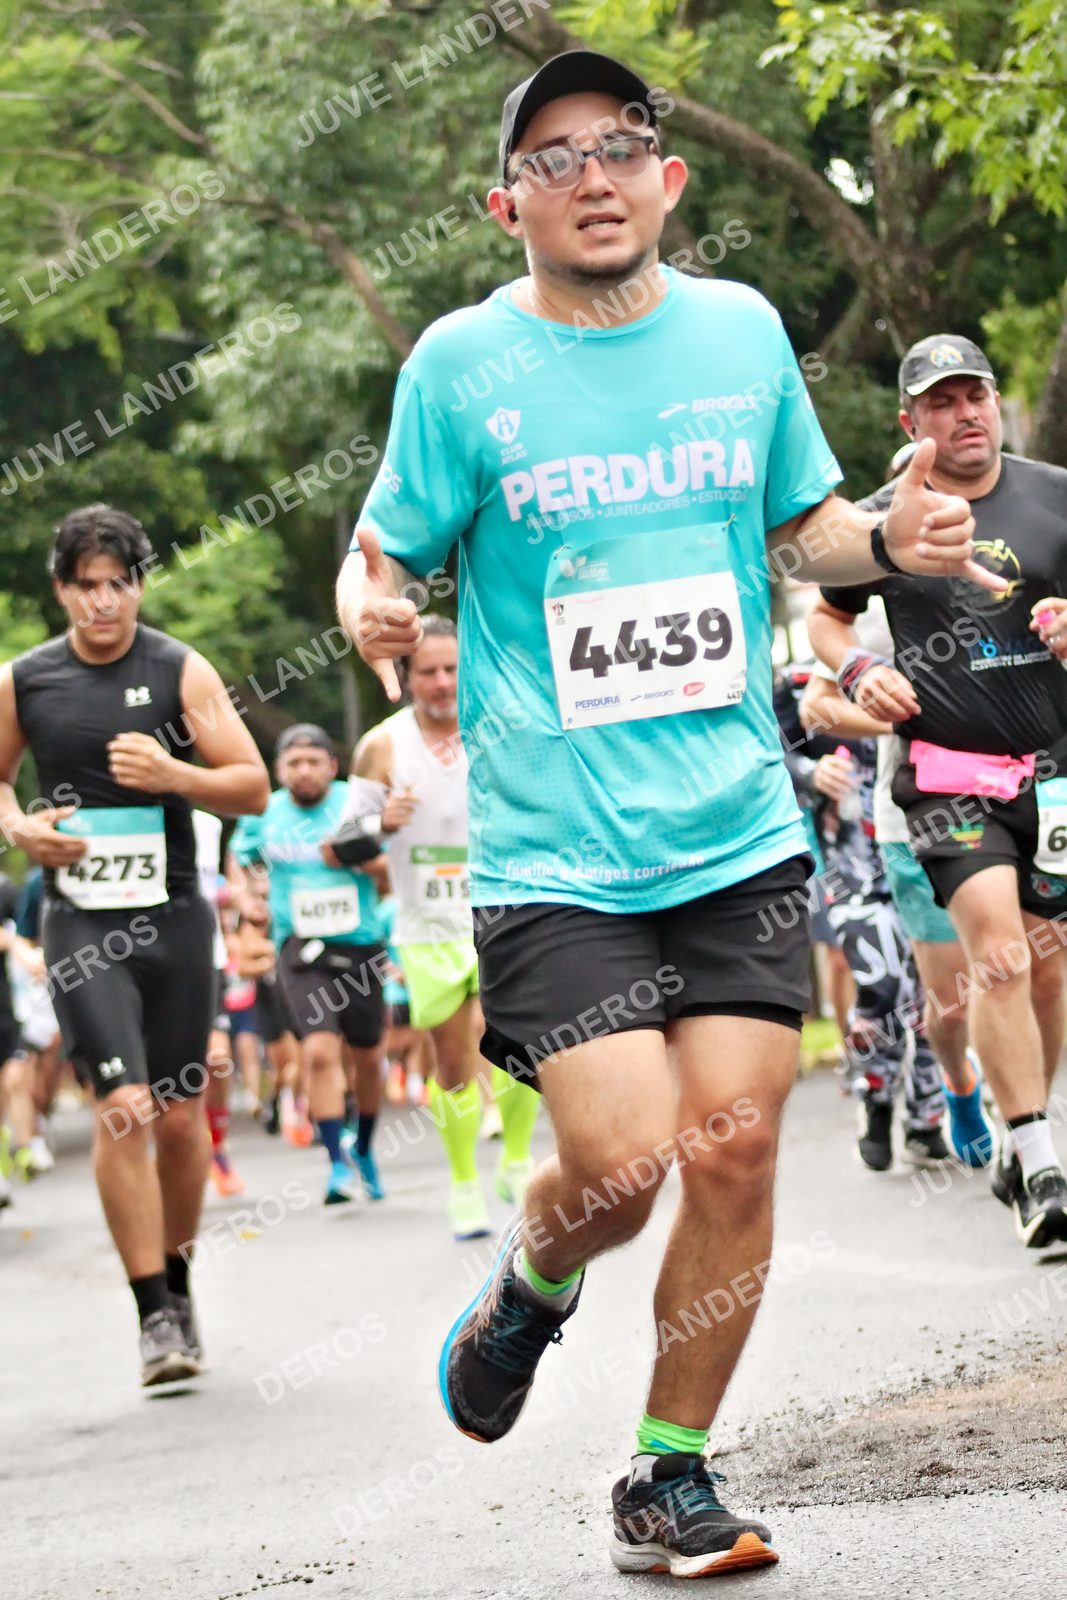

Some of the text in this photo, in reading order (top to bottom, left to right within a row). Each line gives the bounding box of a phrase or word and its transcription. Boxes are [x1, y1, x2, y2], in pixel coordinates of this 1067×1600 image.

[500, 438, 755, 522] PERDURA
[604, 496, 689, 520] JUNTEADORES
[569, 607, 733, 679] 4439
[575, 695, 621, 709] PERDURA
[644, 689, 675, 700] BROOKS
[67, 854, 157, 882] 4273
[505, 860, 555, 879] familia
